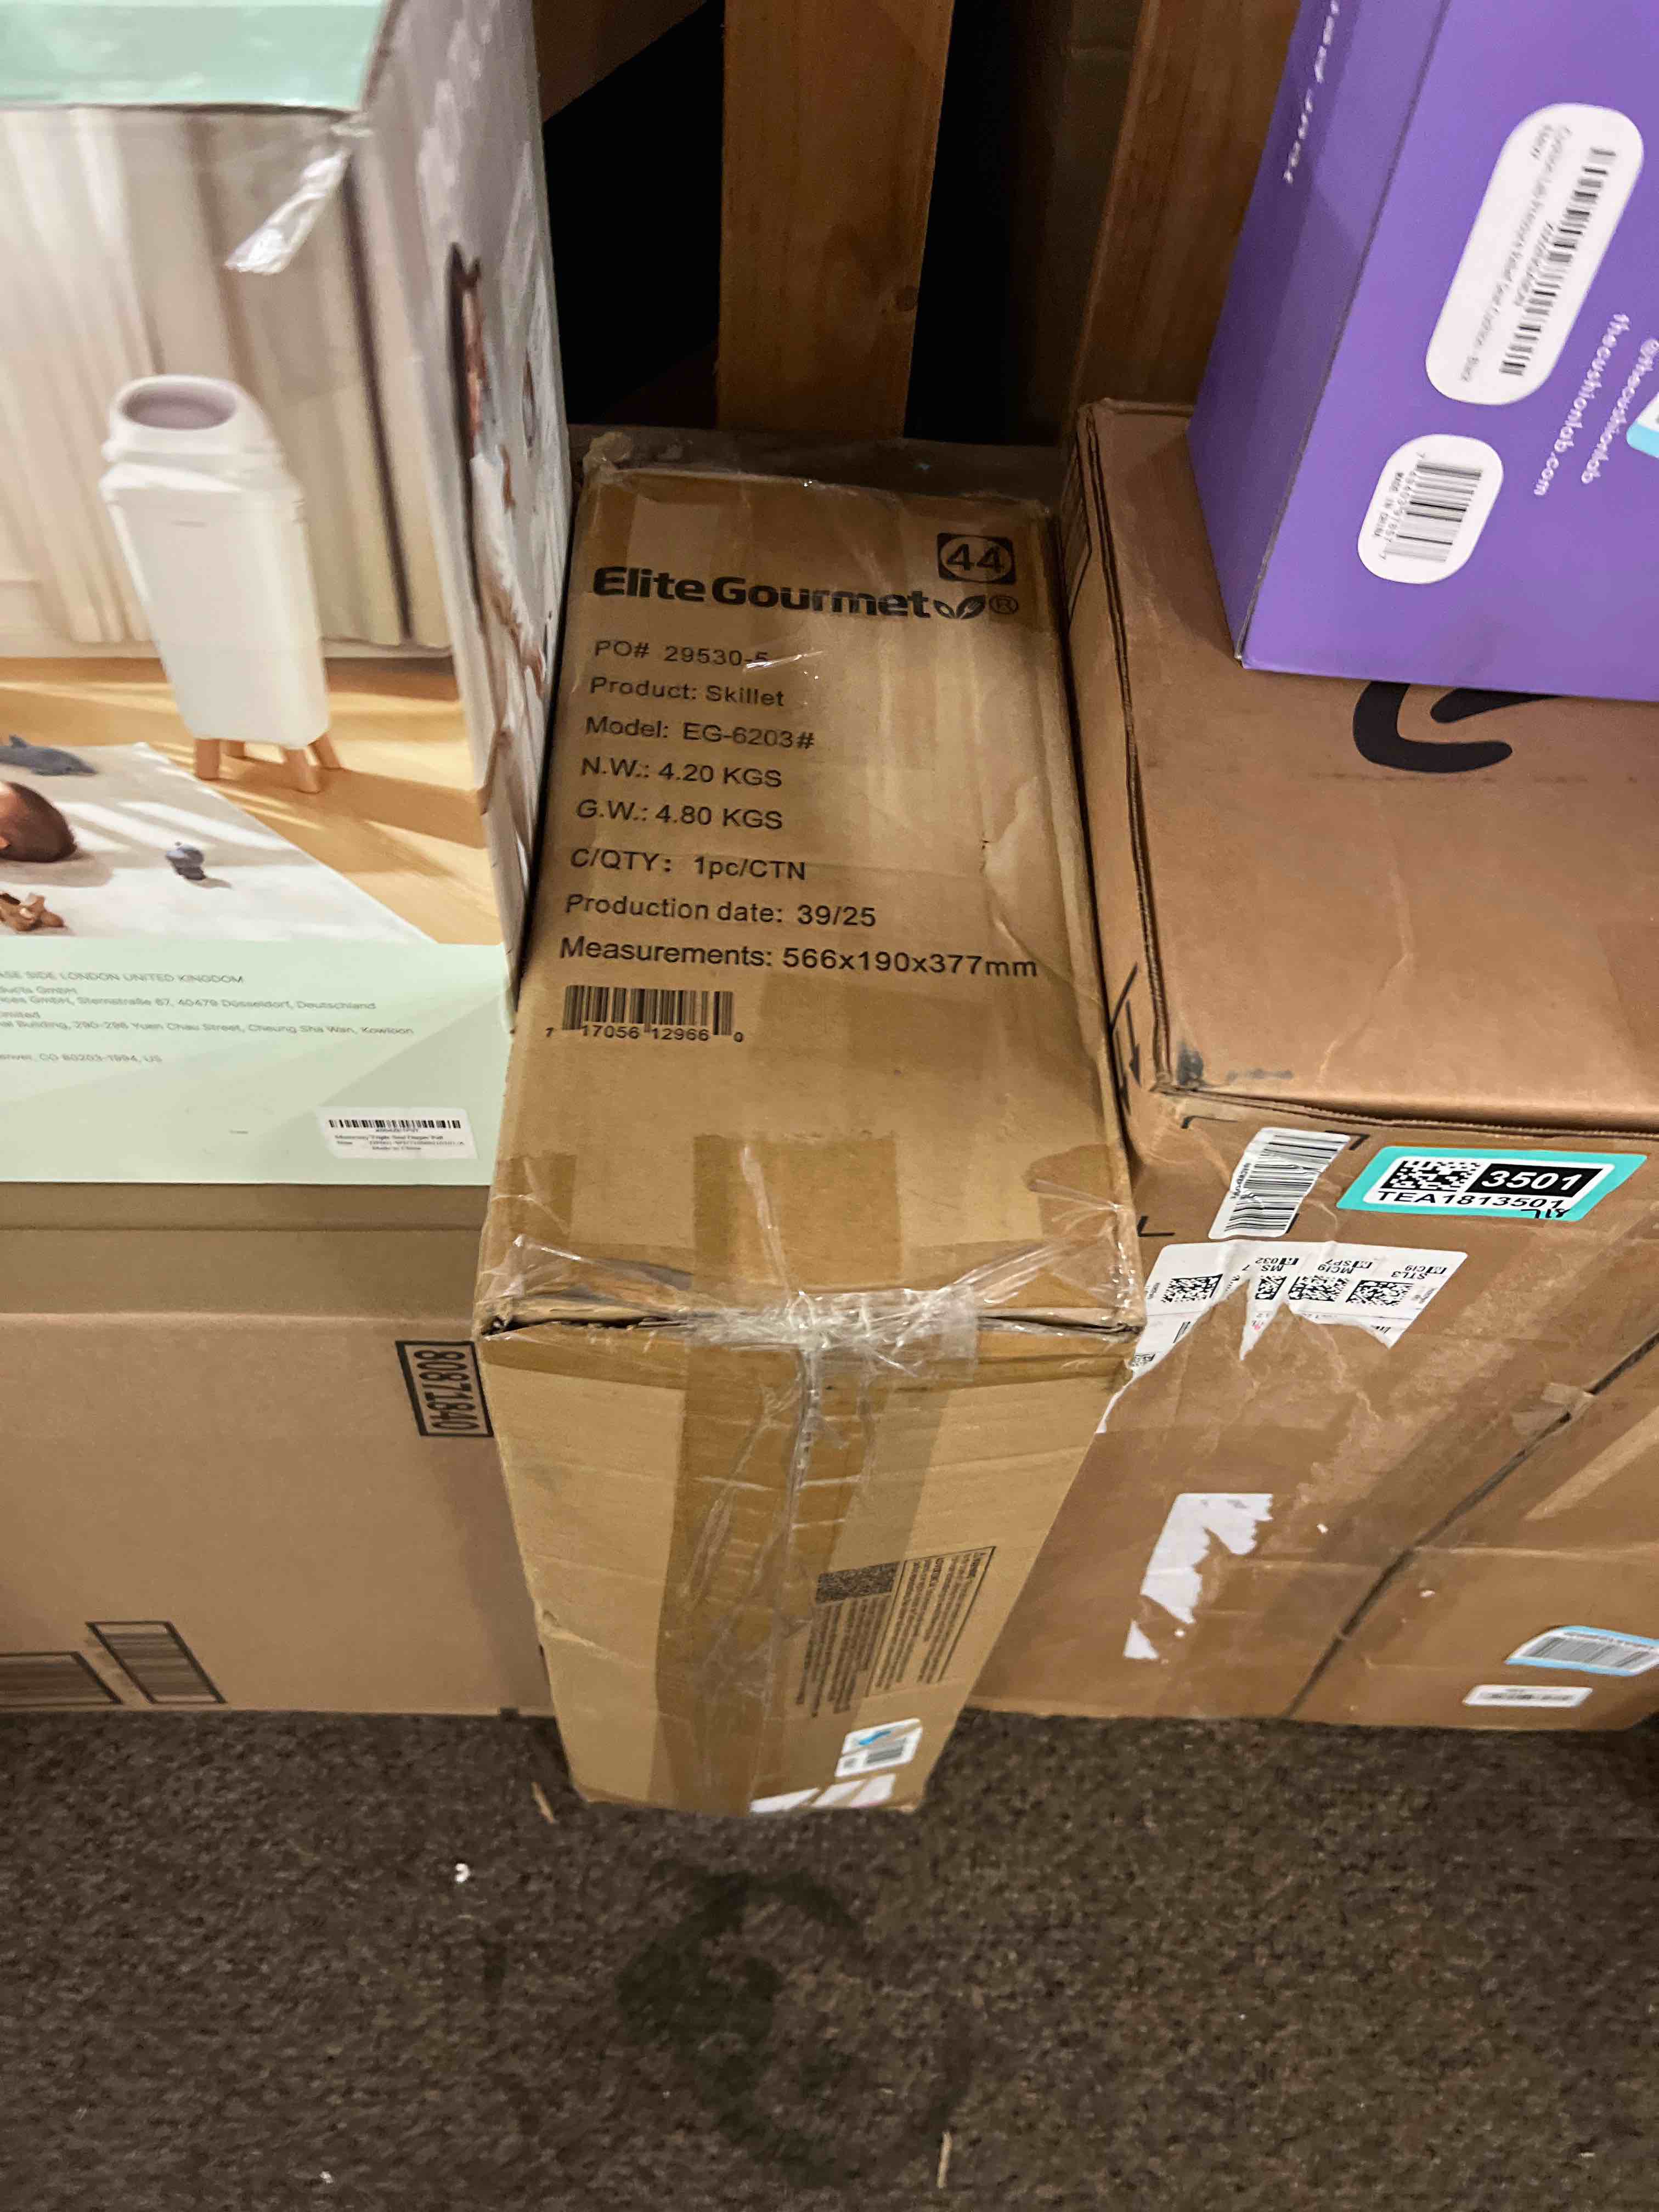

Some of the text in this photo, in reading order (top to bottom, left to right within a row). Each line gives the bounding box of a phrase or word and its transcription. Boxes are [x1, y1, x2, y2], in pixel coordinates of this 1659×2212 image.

[1534, 312, 1630, 496] thecushionlab.com
[946, 543, 1005, 573] 44
[592, 566, 707, 602] Elite
[711, 575, 932, 619] Gourmet
[595, 640, 770, 667] PO# 29530-5
[590, 676, 785, 707] Product: Skillet
[584, 715, 816, 750] Model: EG-6203#
[580, 755, 783, 788] N.W.: 4.20 KGS
[575, 798, 783, 830] G.W.: 4.80 KGS
[570, 847, 806, 881] C/QTY: 1pc/CTN
[565, 893, 877, 928] Production date: 39/25
[559, 935, 1039, 977] Measurements: 566x190x377mm
[60, 973, 120, 981] LONDON
[122, 974, 175, 983] UNITED
[179, 974, 245, 984] KINGDOM
[296, 1001, 377, 1010] Deutschland
[360, 1026, 414, 1035] Kowloon
[582, 1024, 641, 1040] 17056
[651, 1027, 709, 1042] 12966
[1481, 1170, 1583, 1191] 3501
[1377, 1190, 1566, 1209] TEA1813501
[1390, 1270, 1427, 1280] STL3
[414, 1350, 479, 1430] 80871840
